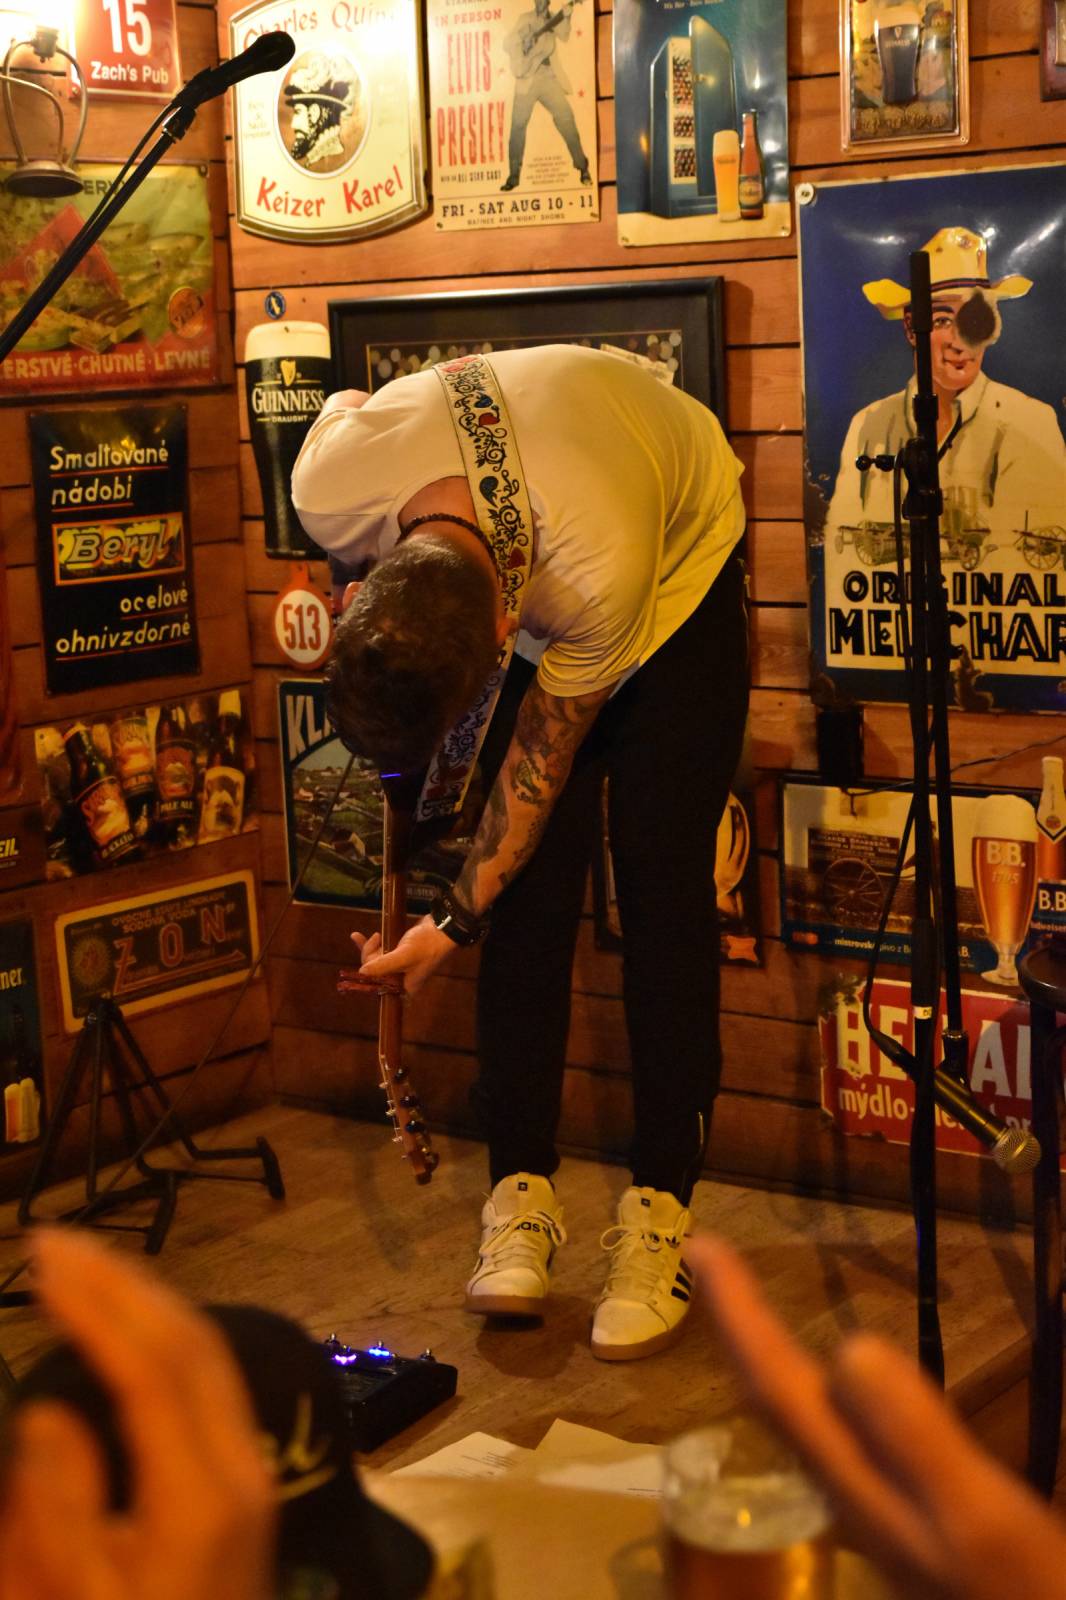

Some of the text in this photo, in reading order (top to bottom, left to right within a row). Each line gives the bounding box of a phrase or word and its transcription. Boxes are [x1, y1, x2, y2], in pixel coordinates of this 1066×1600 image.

[102, 0, 152, 56] 15
[454, 8, 502, 24] PERSON
[90, 60, 169, 85] Zach's Pub
[447, 30, 491, 96] ELVIS
[436, 101, 505, 168] PRESLEY
[256, 164, 404, 217] Keizer Karel
[442, 204, 465, 218] FRI
[479, 201, 504, 215] SAT
[510, 198, 541, 213] AUG
[548, 197, 563, 211] 10
[580, 195, 593, 208] 11
[541, 213, 565, 221] SHOWS
[78, 350, 146, 376] CHUTNÉ
[154, 344, 210, 372] LEVNÉ
[252, 387, 325, 413] GUINNESS
[271, 415, 308, 423] DRAUGHT
[50, 440, 169, 471] Smaltované
[66, 524, 171, 569] Beryl
[120, 582, 188, 613] ocelové
[55, 615, 191, 653] ohnivzdorné
[281, 603, 322, 651] 513
[838, 1082, 909, 1121] mýdlo
